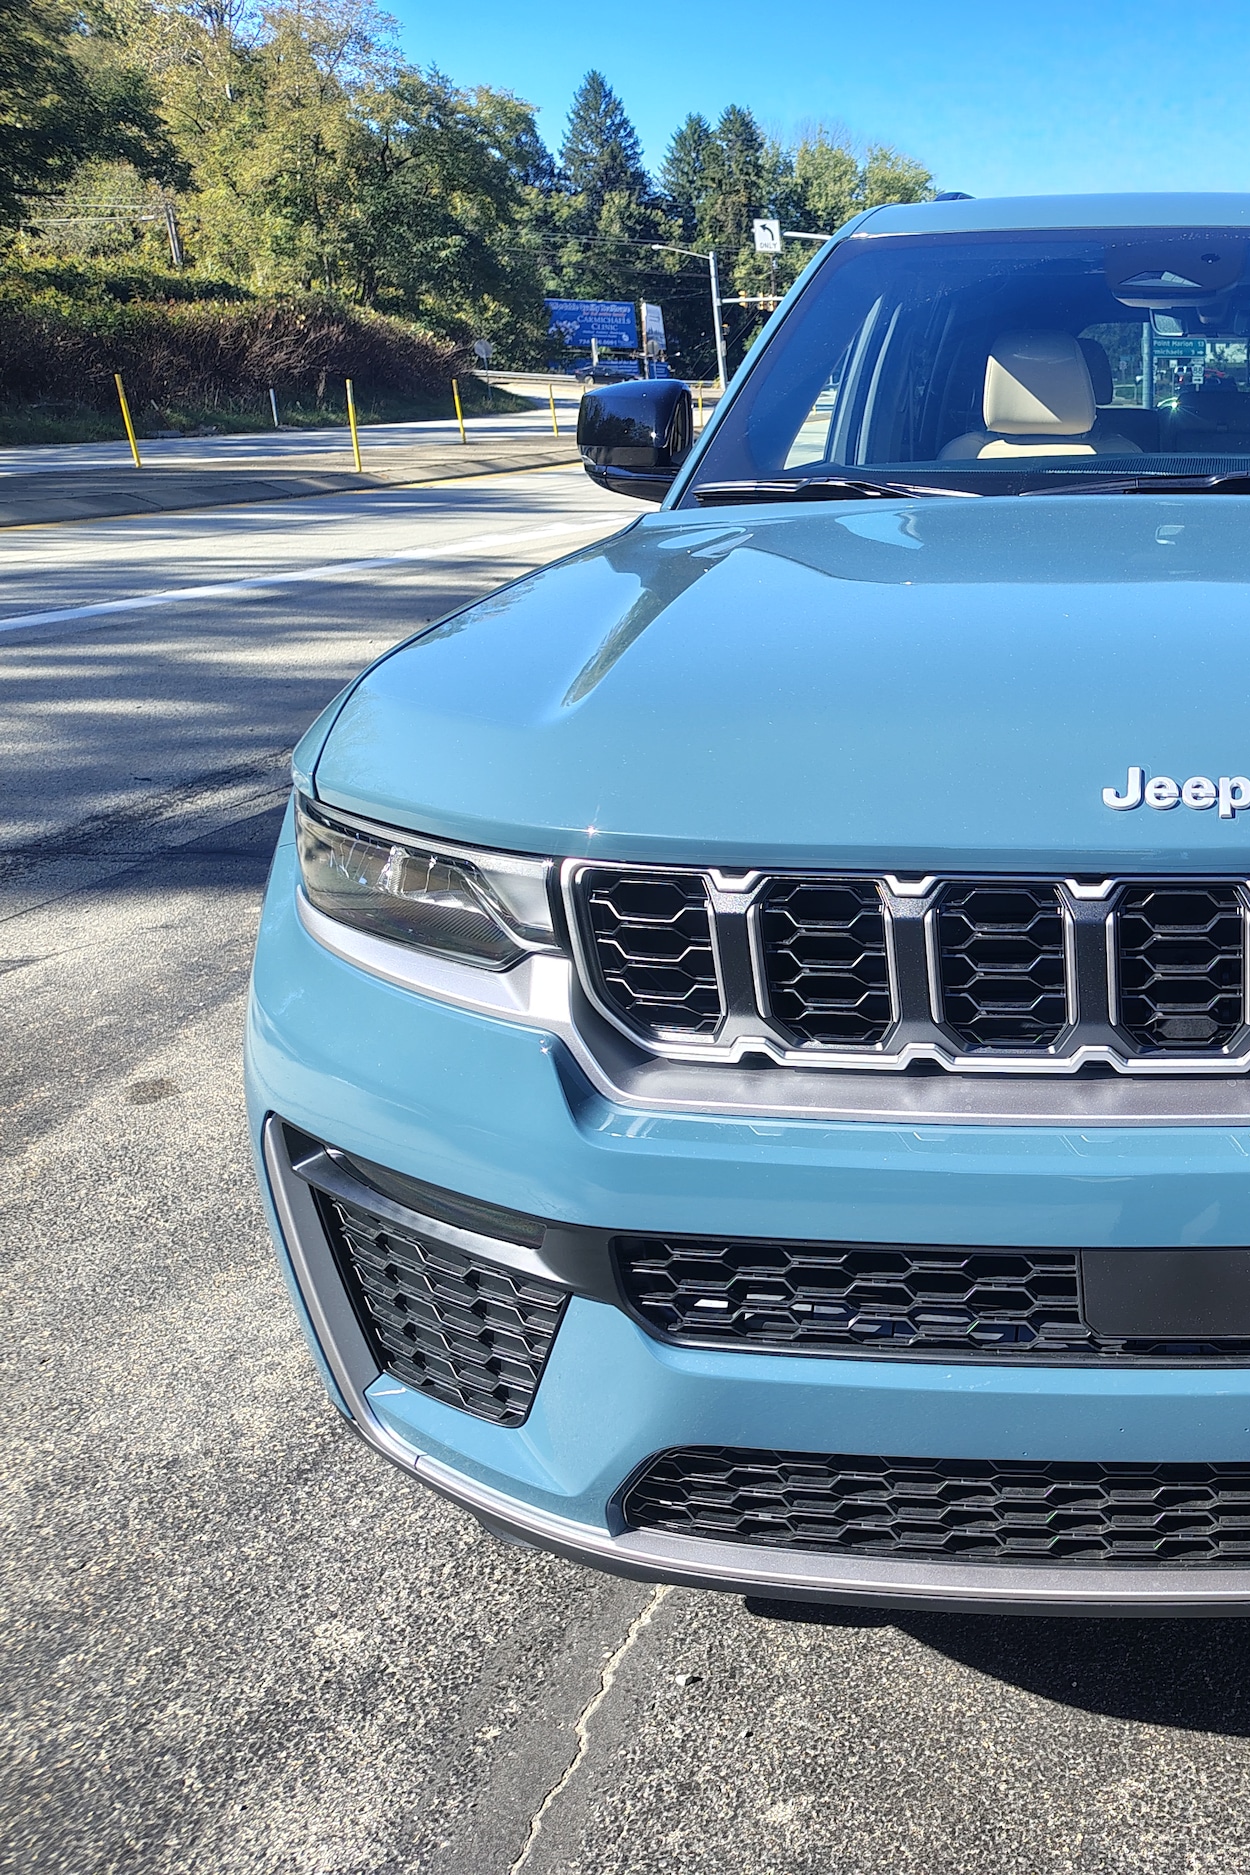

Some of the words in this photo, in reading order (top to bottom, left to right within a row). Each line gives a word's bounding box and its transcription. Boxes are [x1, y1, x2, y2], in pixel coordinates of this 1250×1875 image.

[577, 315, 632, 325] CARMICHAELS
[591, 323, 619, 331] CLINIC
[1193, 366, 1203, 375] 88
